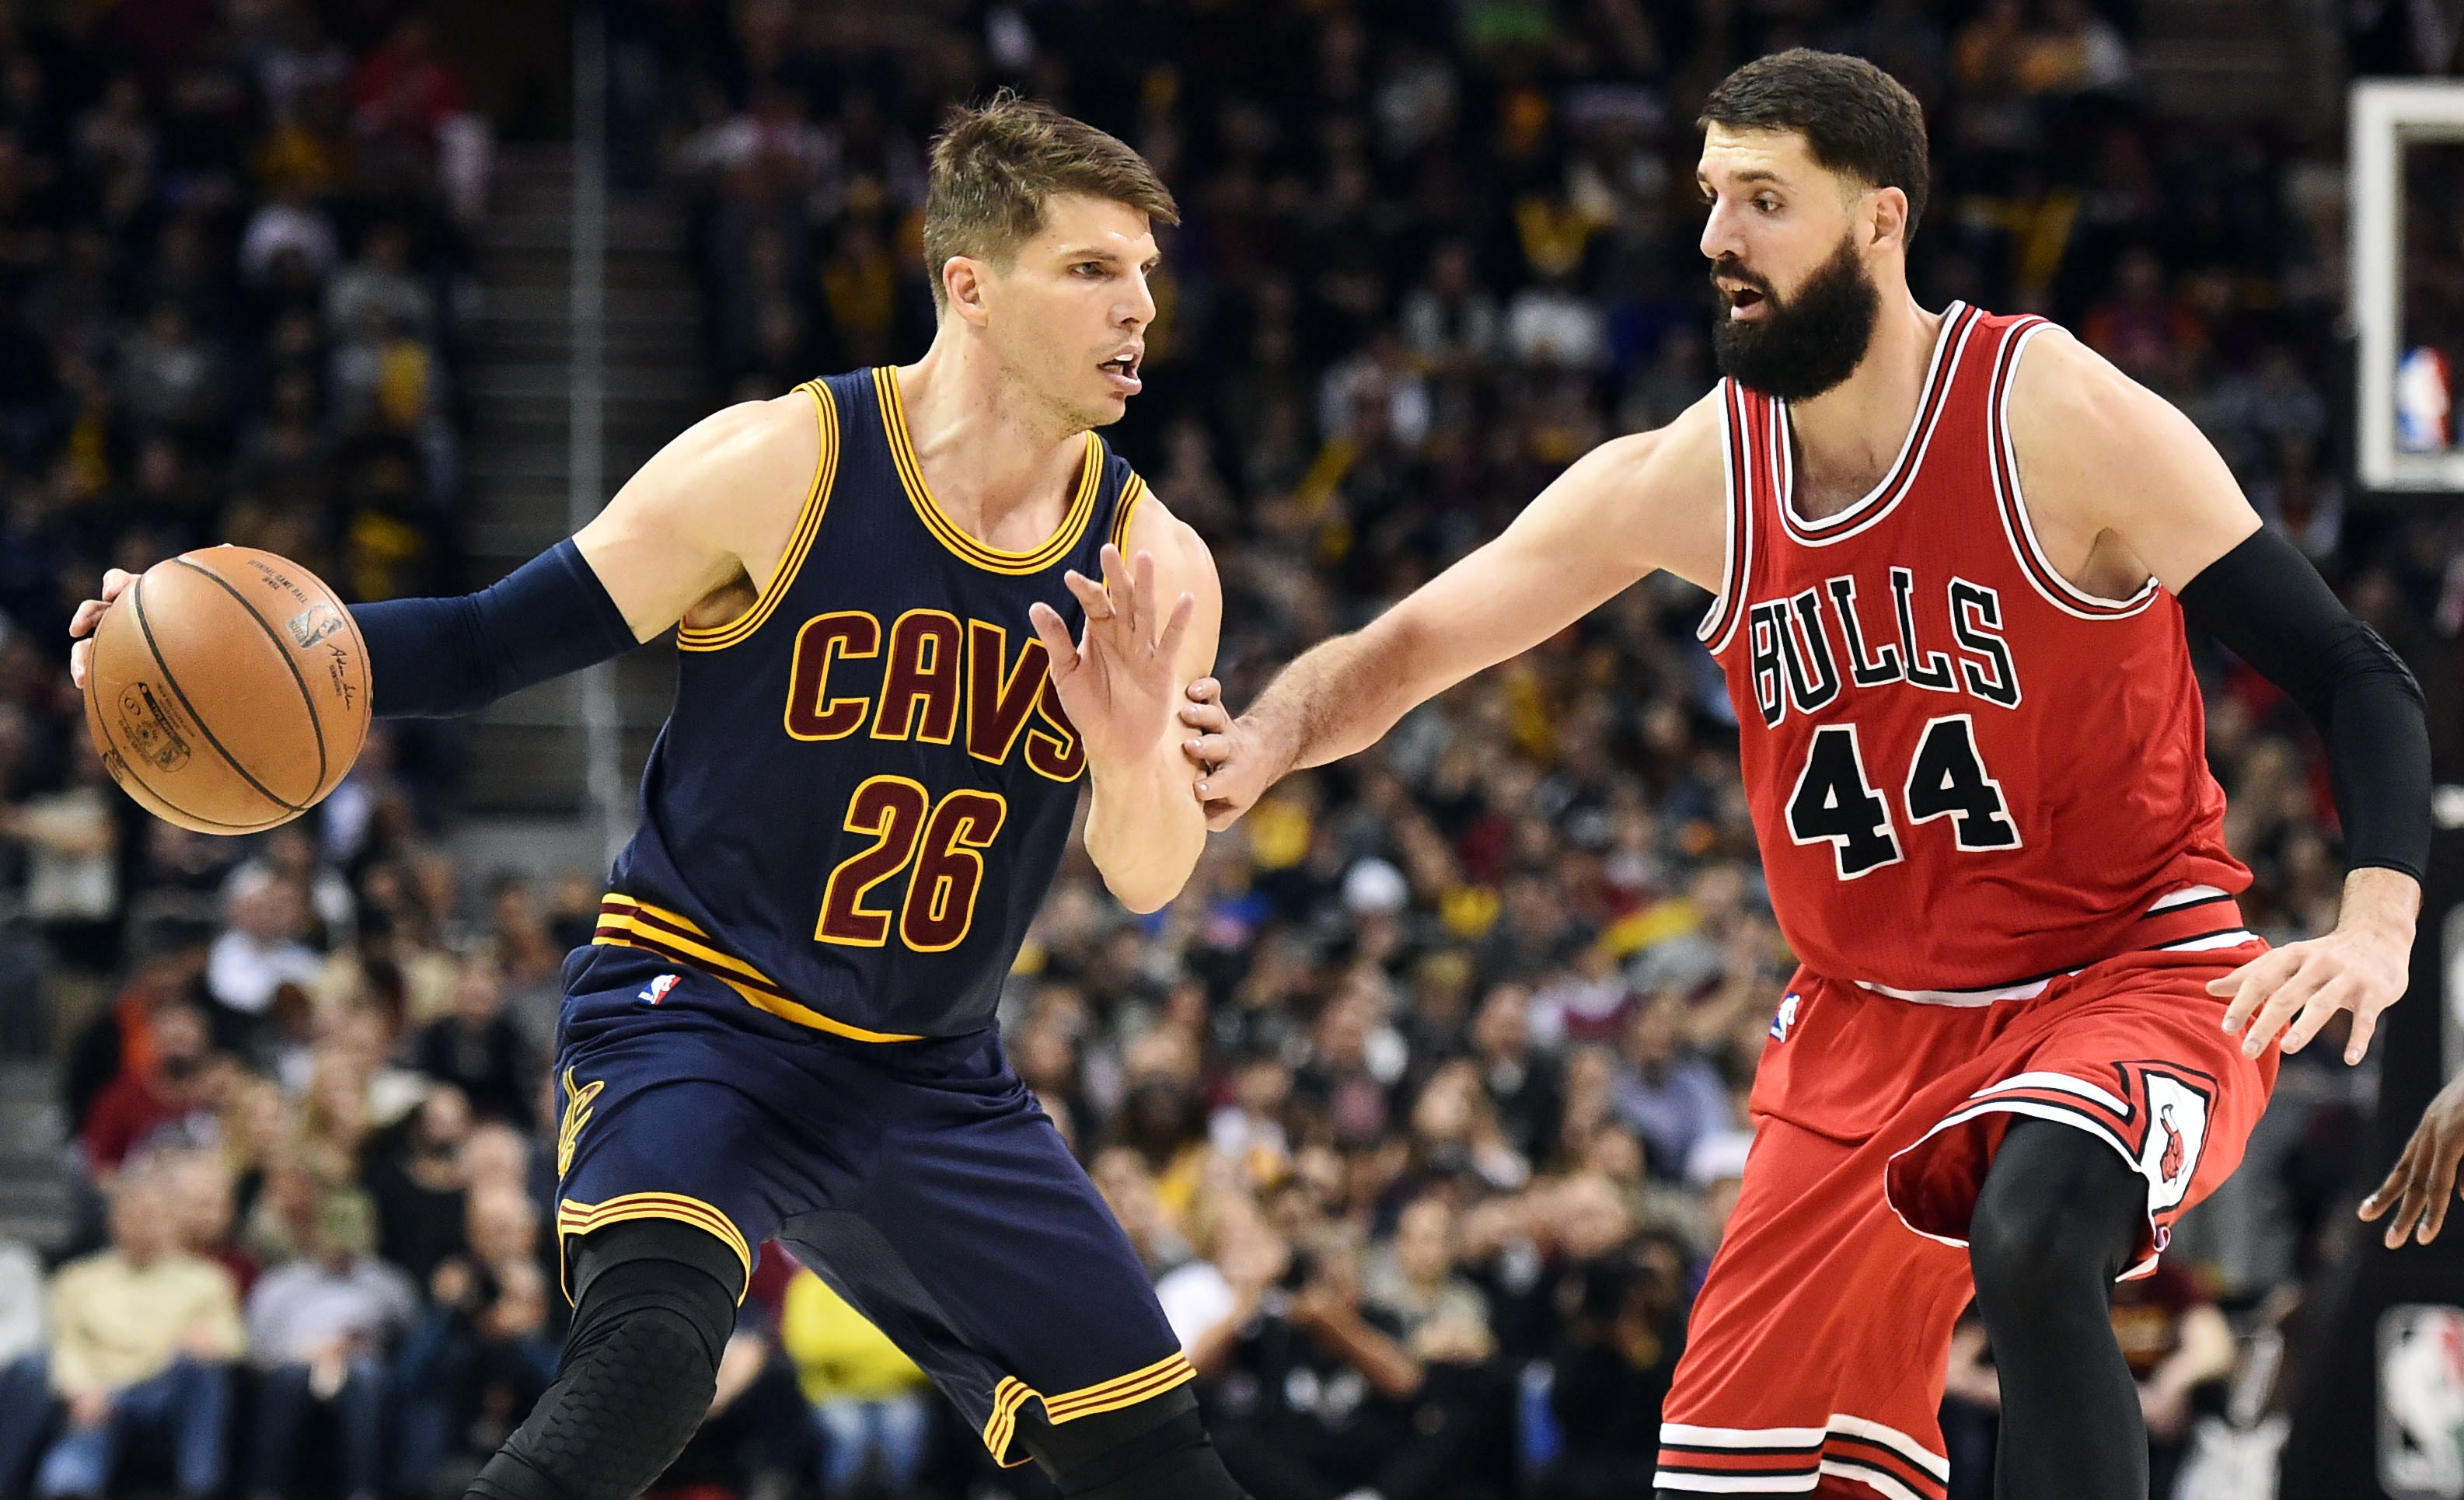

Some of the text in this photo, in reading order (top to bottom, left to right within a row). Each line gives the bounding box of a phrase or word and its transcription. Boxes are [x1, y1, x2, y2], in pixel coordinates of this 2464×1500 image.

[784, 608, 1087, 783] CAVS
[1750, 566, 2023, 731] BULLS
[814, 774, 1007, 953] 26
[1785, 713, 2023, 881] 44
